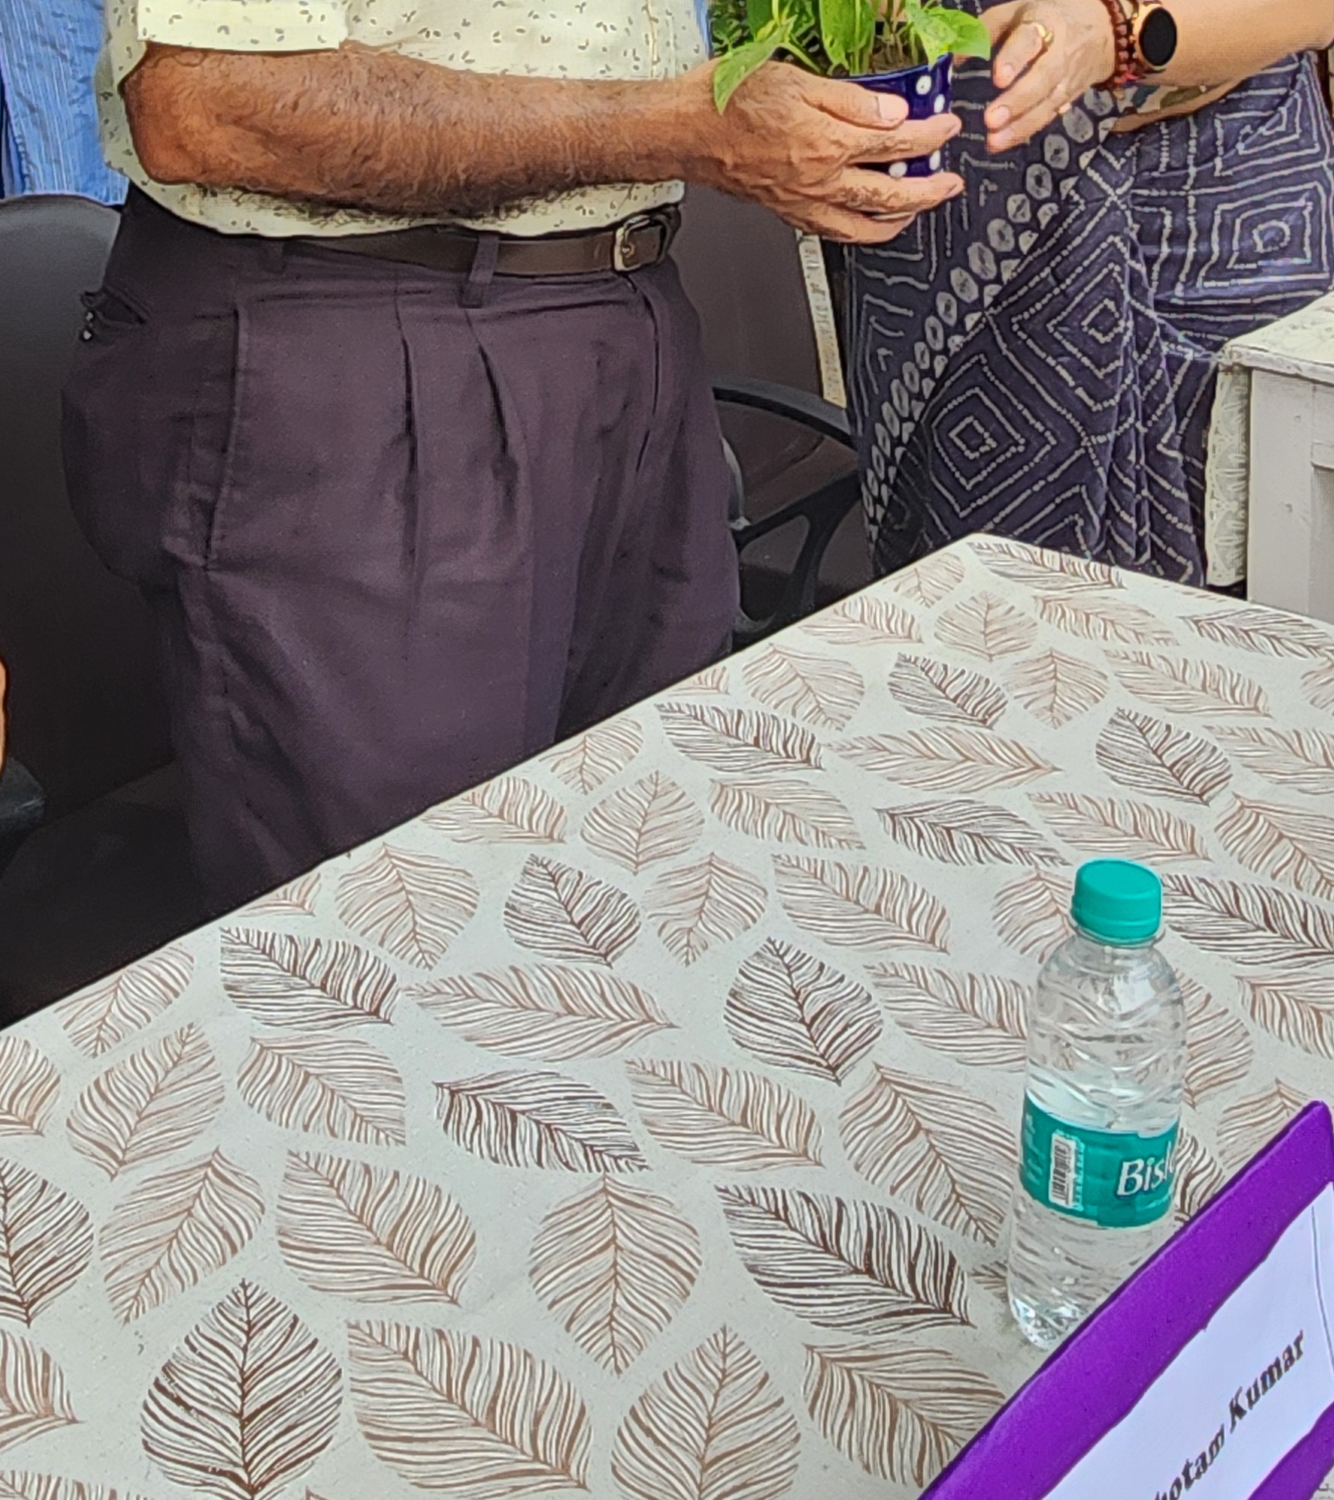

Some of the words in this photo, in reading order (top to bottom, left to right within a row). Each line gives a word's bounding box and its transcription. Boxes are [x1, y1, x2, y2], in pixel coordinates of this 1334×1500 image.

[1116, 1139, 1175, 1197] Bisl
[1154, 1423, 1226, 1500] otam
[1229, 1329, 1304, 1434] Kumar
